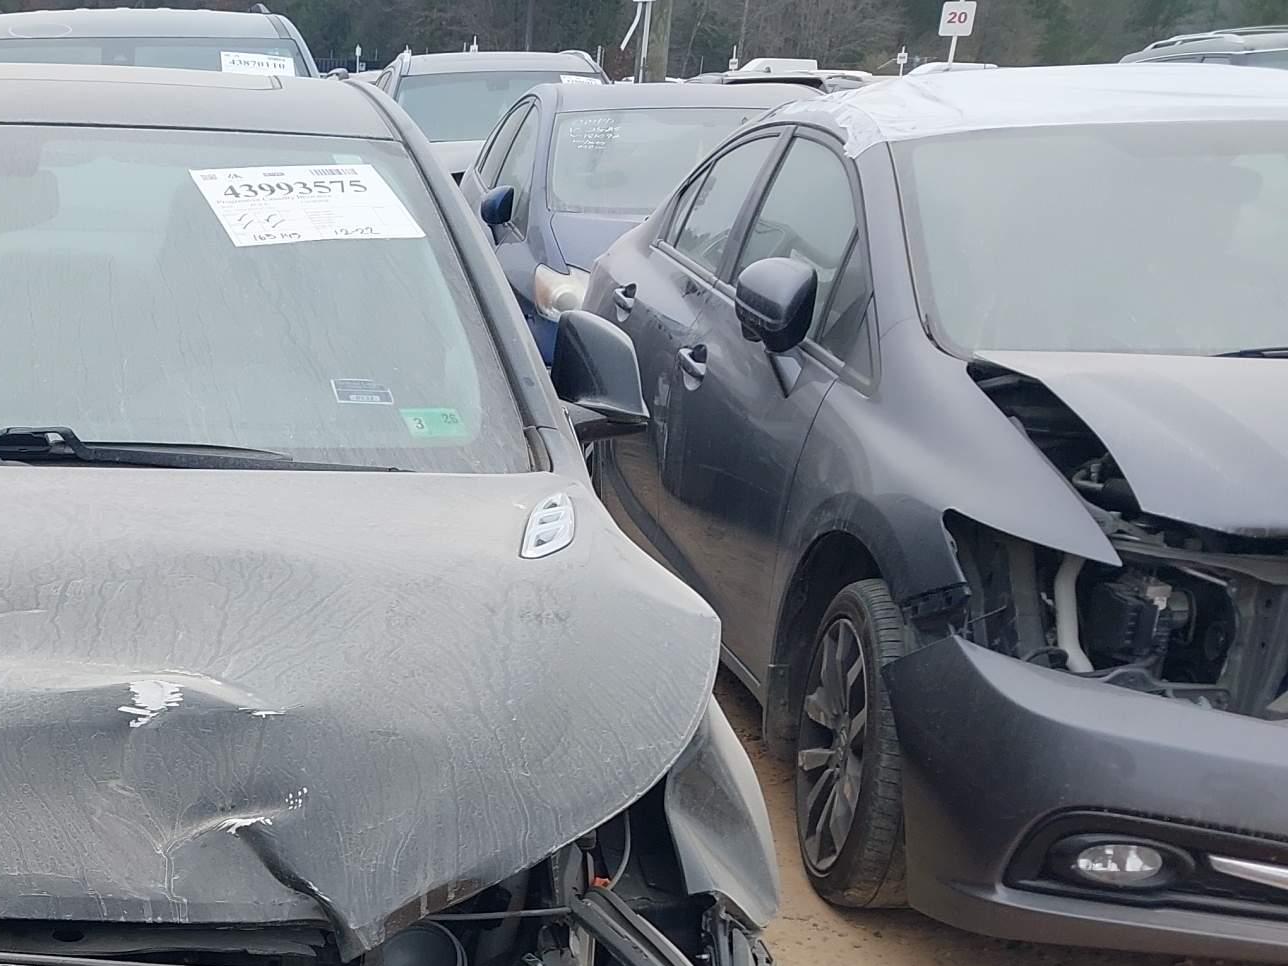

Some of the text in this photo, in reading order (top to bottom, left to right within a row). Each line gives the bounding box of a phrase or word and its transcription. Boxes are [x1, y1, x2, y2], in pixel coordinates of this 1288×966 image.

[946, 11, 968, 24] 20
[223, 179, 368, 199] 43993575
[413, 416, 425, 430] 3
